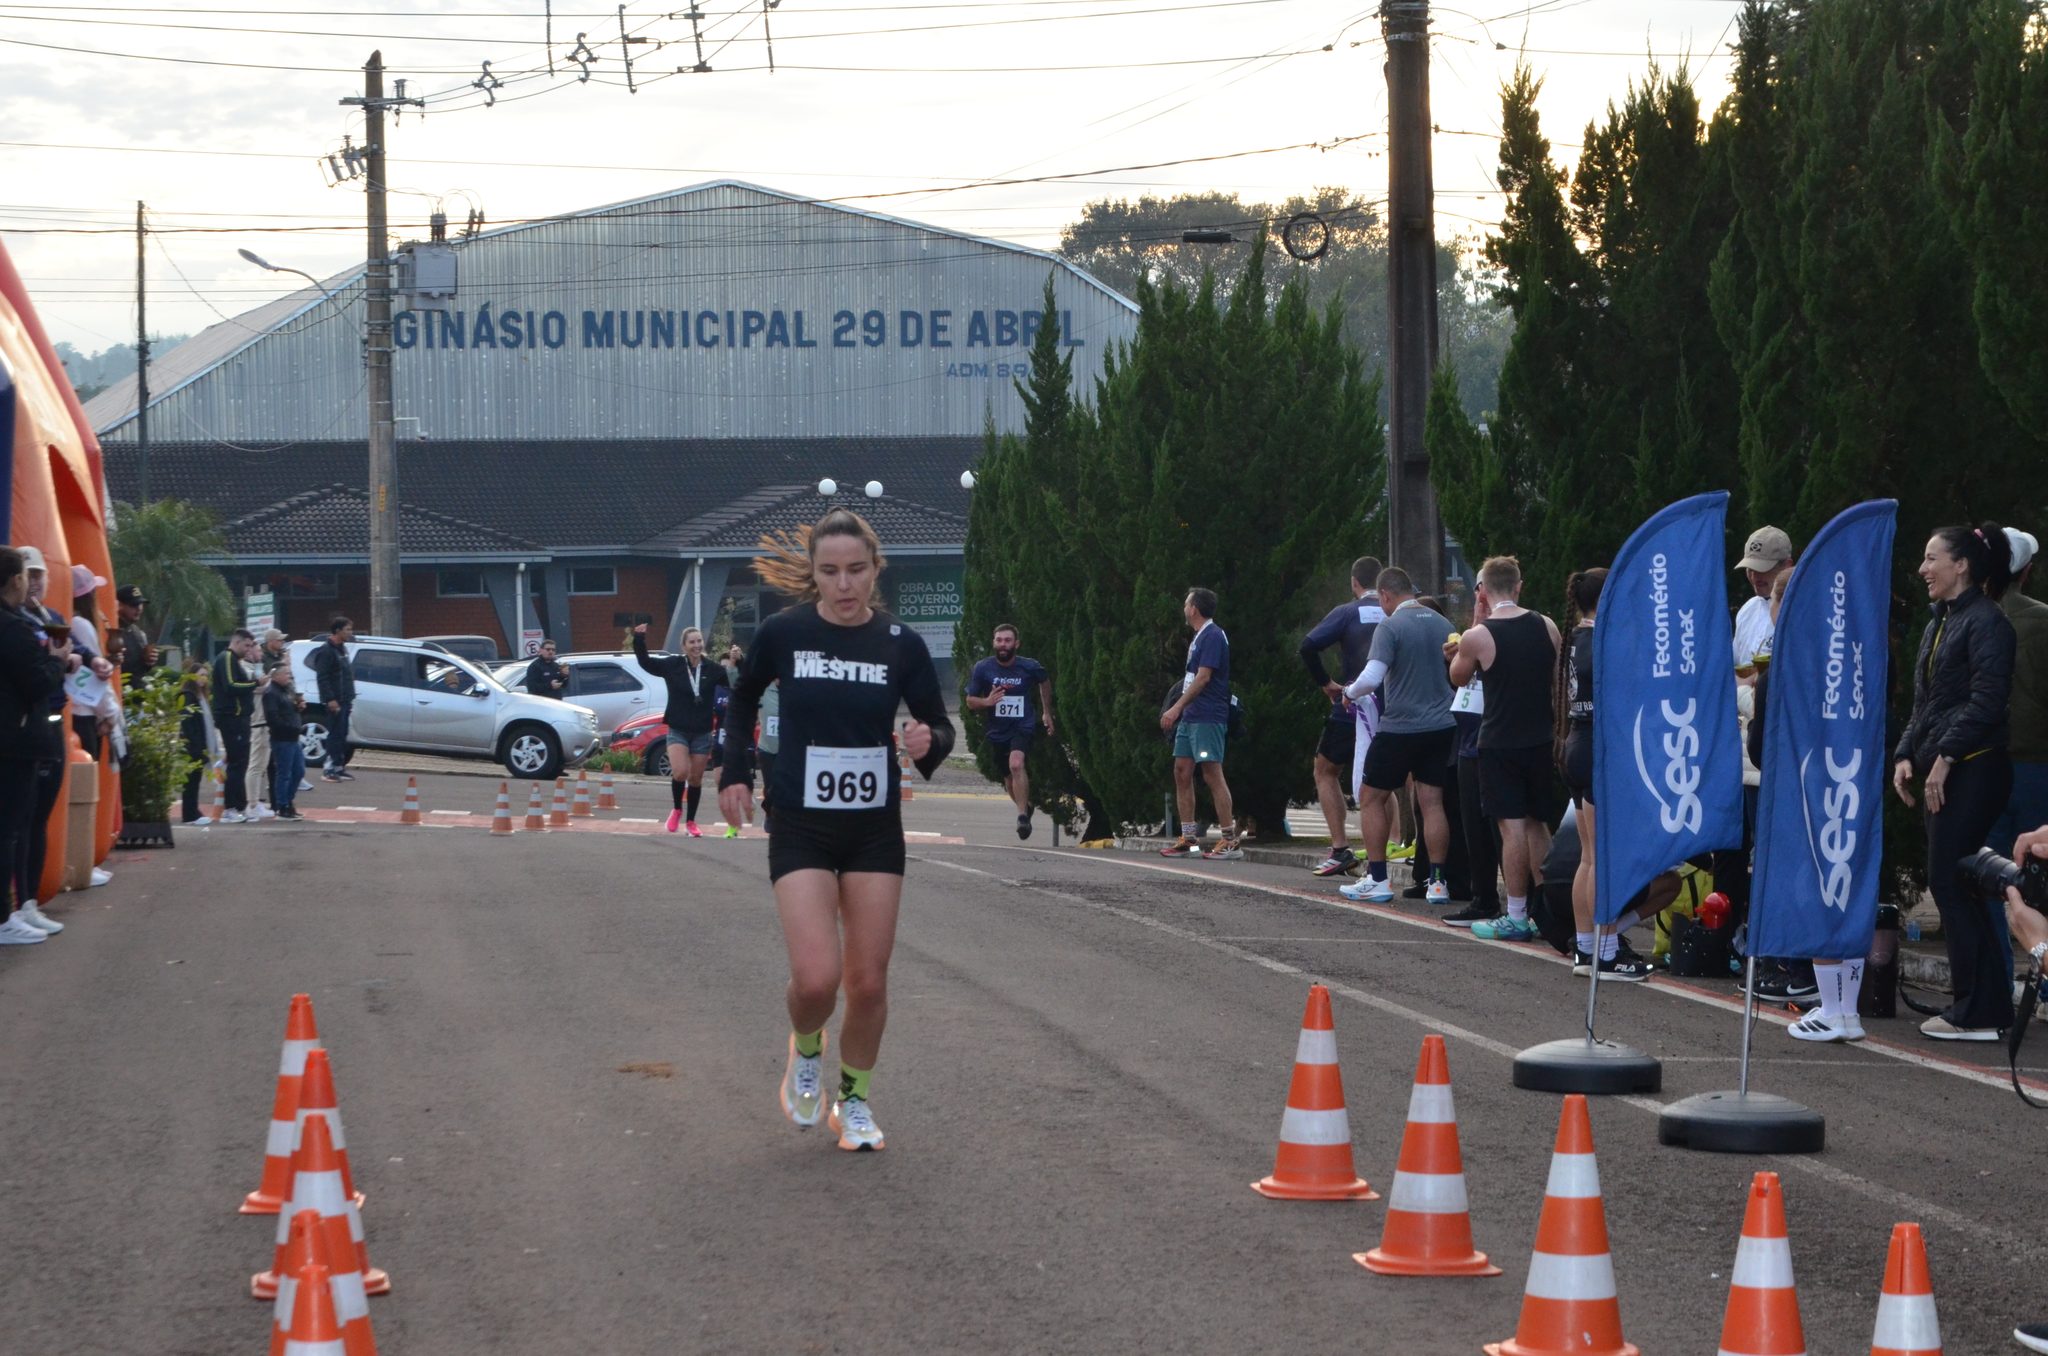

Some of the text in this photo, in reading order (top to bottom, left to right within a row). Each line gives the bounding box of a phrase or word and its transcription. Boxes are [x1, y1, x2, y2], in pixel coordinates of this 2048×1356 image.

[393, 303, 566, 349] GINÁSIO
[583, 310, 817, 349] MUNICIPAL
[833, 310, 885, 348] 29
[900, 310, 951, 348] DE
[946, 363, 988, 378] ADM
[899, 582, 955, 593] OBRA DO
[899, 594, 959, 604] GOVERNO
[899, 605, 918, 616] DO
[1648, 552, 1670, 679] Fecomércio
[1822, 571, 1846, 720] Fecomércio
[794, 658, 888, 685] MESTRE
[999, 704, 1019, 716] 871
[816, 770, 877, 804] 969
[1613, 963, 1636, 972] FILA
